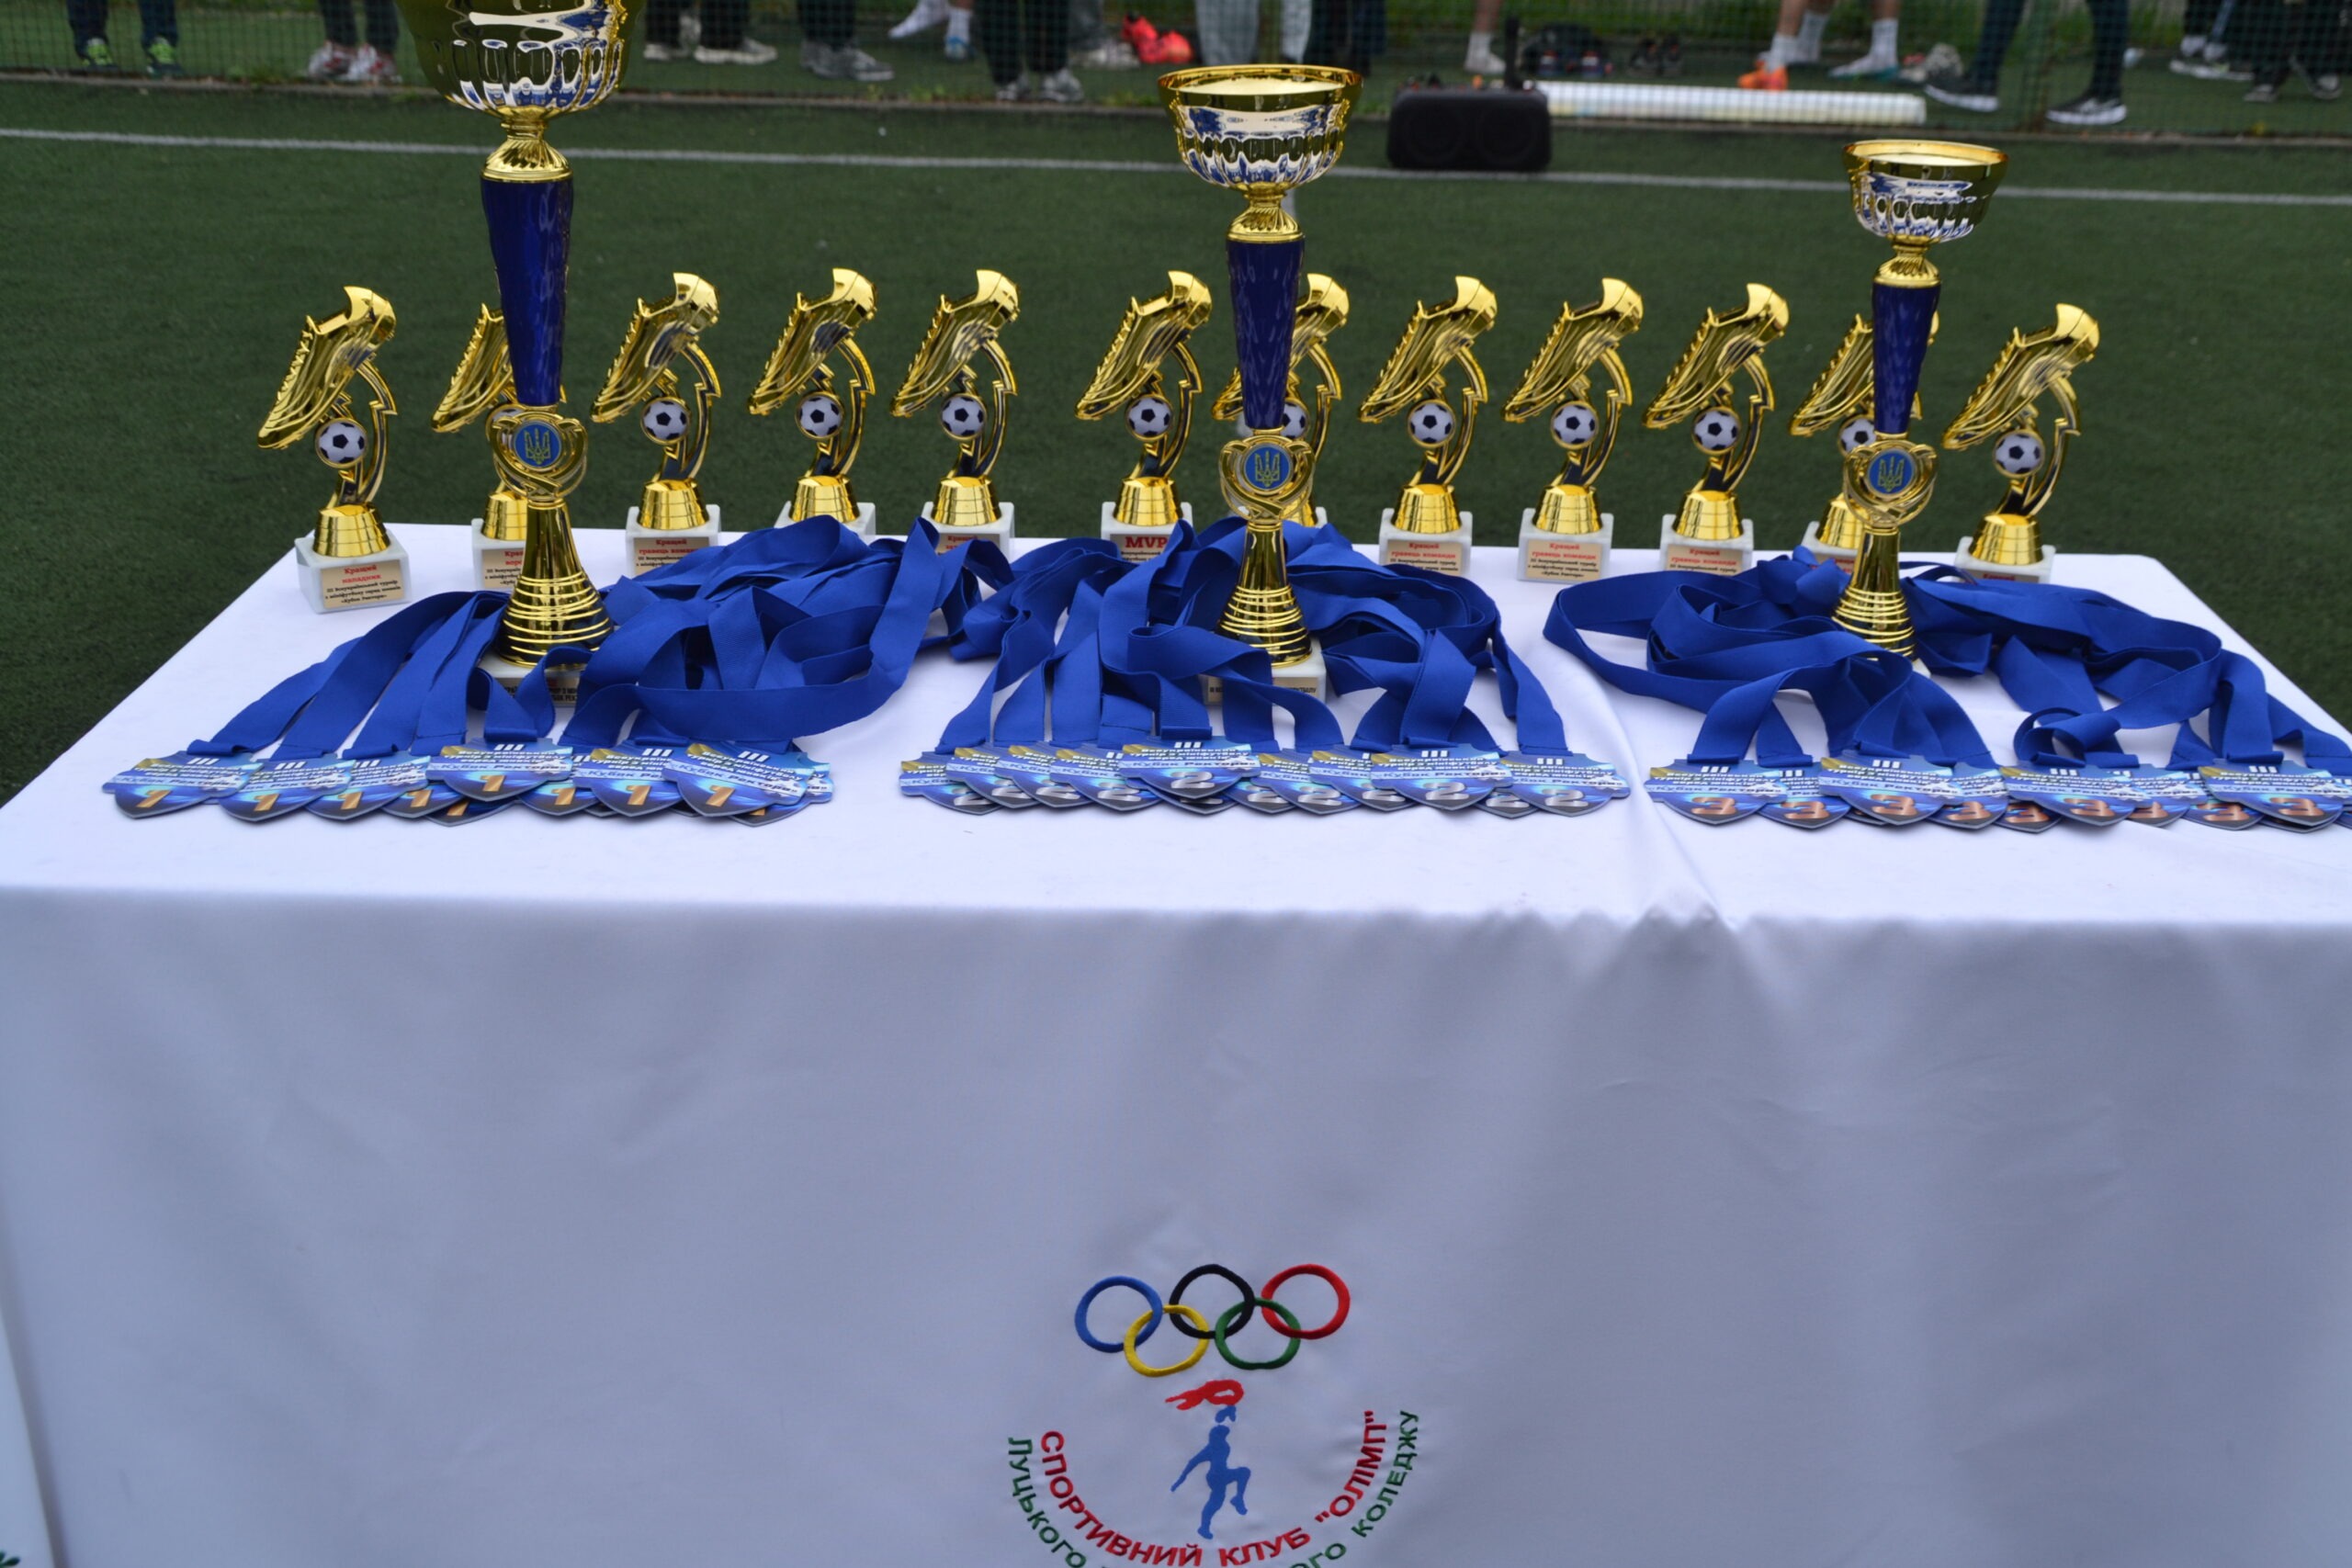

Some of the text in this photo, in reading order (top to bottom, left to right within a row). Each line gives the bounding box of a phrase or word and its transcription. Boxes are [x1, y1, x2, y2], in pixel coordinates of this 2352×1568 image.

[1125, 536, 1169, 548] MVP
[344, 564, 378, 575] Кращий
[480, 775, 506, 792] 1
[1170, 771, 1216, 789] 2
[136, 789, 172, 808] 1
[338, 791, 363, 810] 1
[407, 789, 432, 807] 1
[552, 787, 576, 806] 1
[626, 785, 651, 806] 1
[705, 784, 735, 807] 1
[1098, 782, 1142, 802] 2
[1297, 786, 1342, 807] 2
[1423, 782, 1470, 801] 2
[1542, 789, 1589, 807] 2
[254, 793, 280, 812] 1
[1691, 796, 1738, 815] 3
[1780, 801, 1831, 820] 3
[1870, 794, 1918, 816] 3
[2064, 798, 2116, 817] 3
[2269, 797, 2325, 817] 3
[1041, 1410, 1387, 1567] СПОРТИВНИЙ КЛУБ "ОЛІМП"
